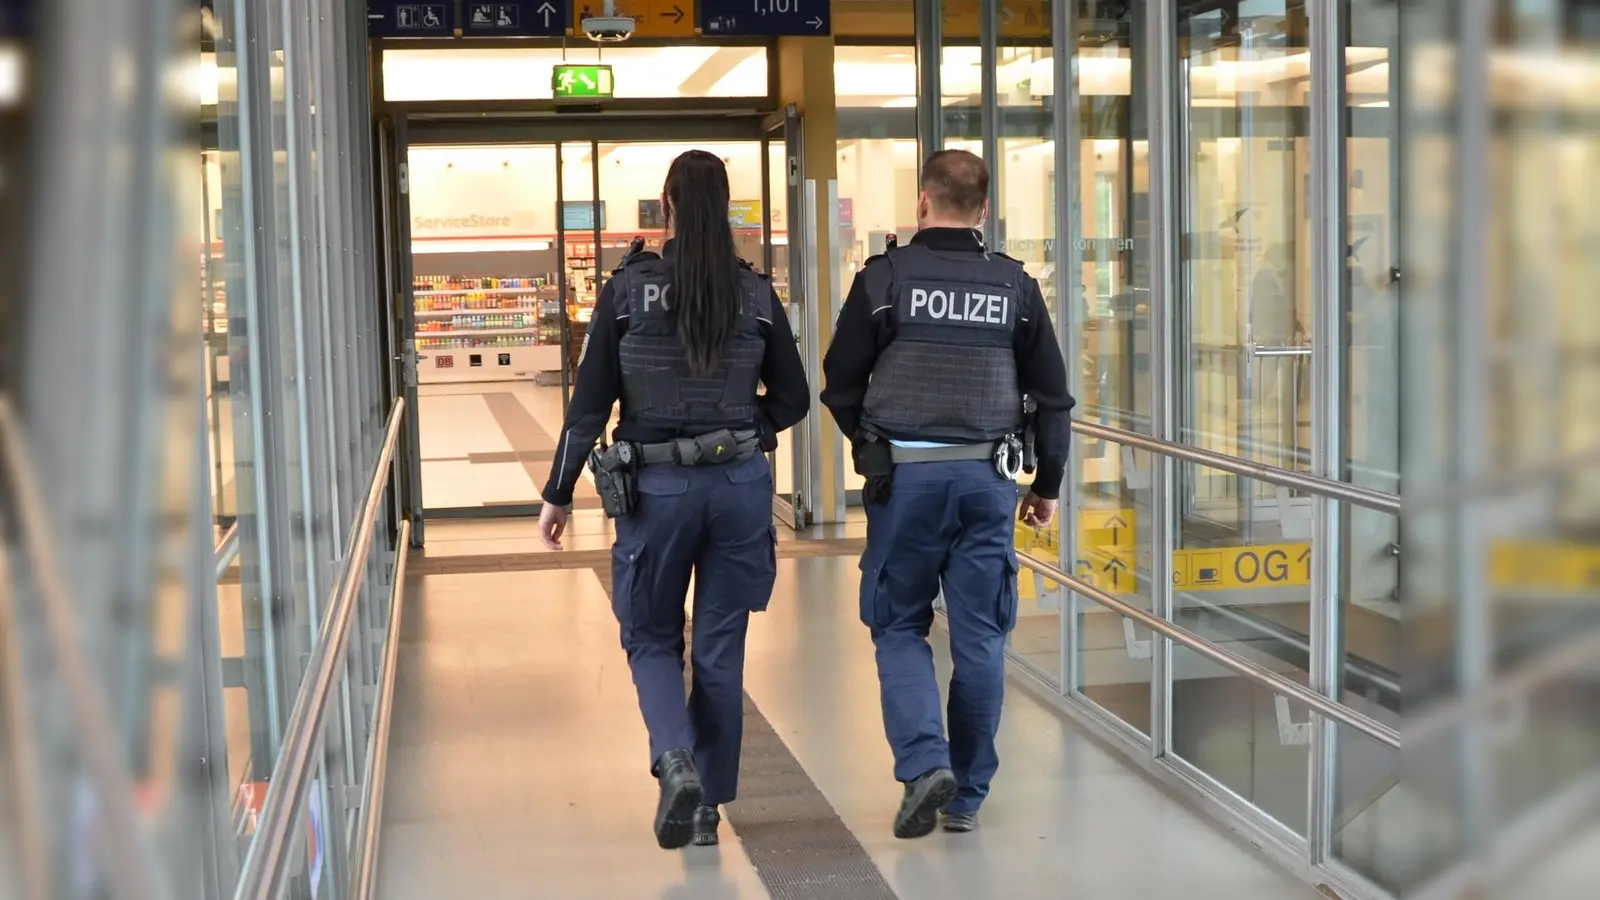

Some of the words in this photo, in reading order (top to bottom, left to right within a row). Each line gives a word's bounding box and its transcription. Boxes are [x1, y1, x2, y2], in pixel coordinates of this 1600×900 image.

[414, 213, 512, 229] ServiceStore
[910, 288, 1009, 325] POLIZEI
[437, 357, 452, 366] DB
[1234, 549, 1288, 583] OG
